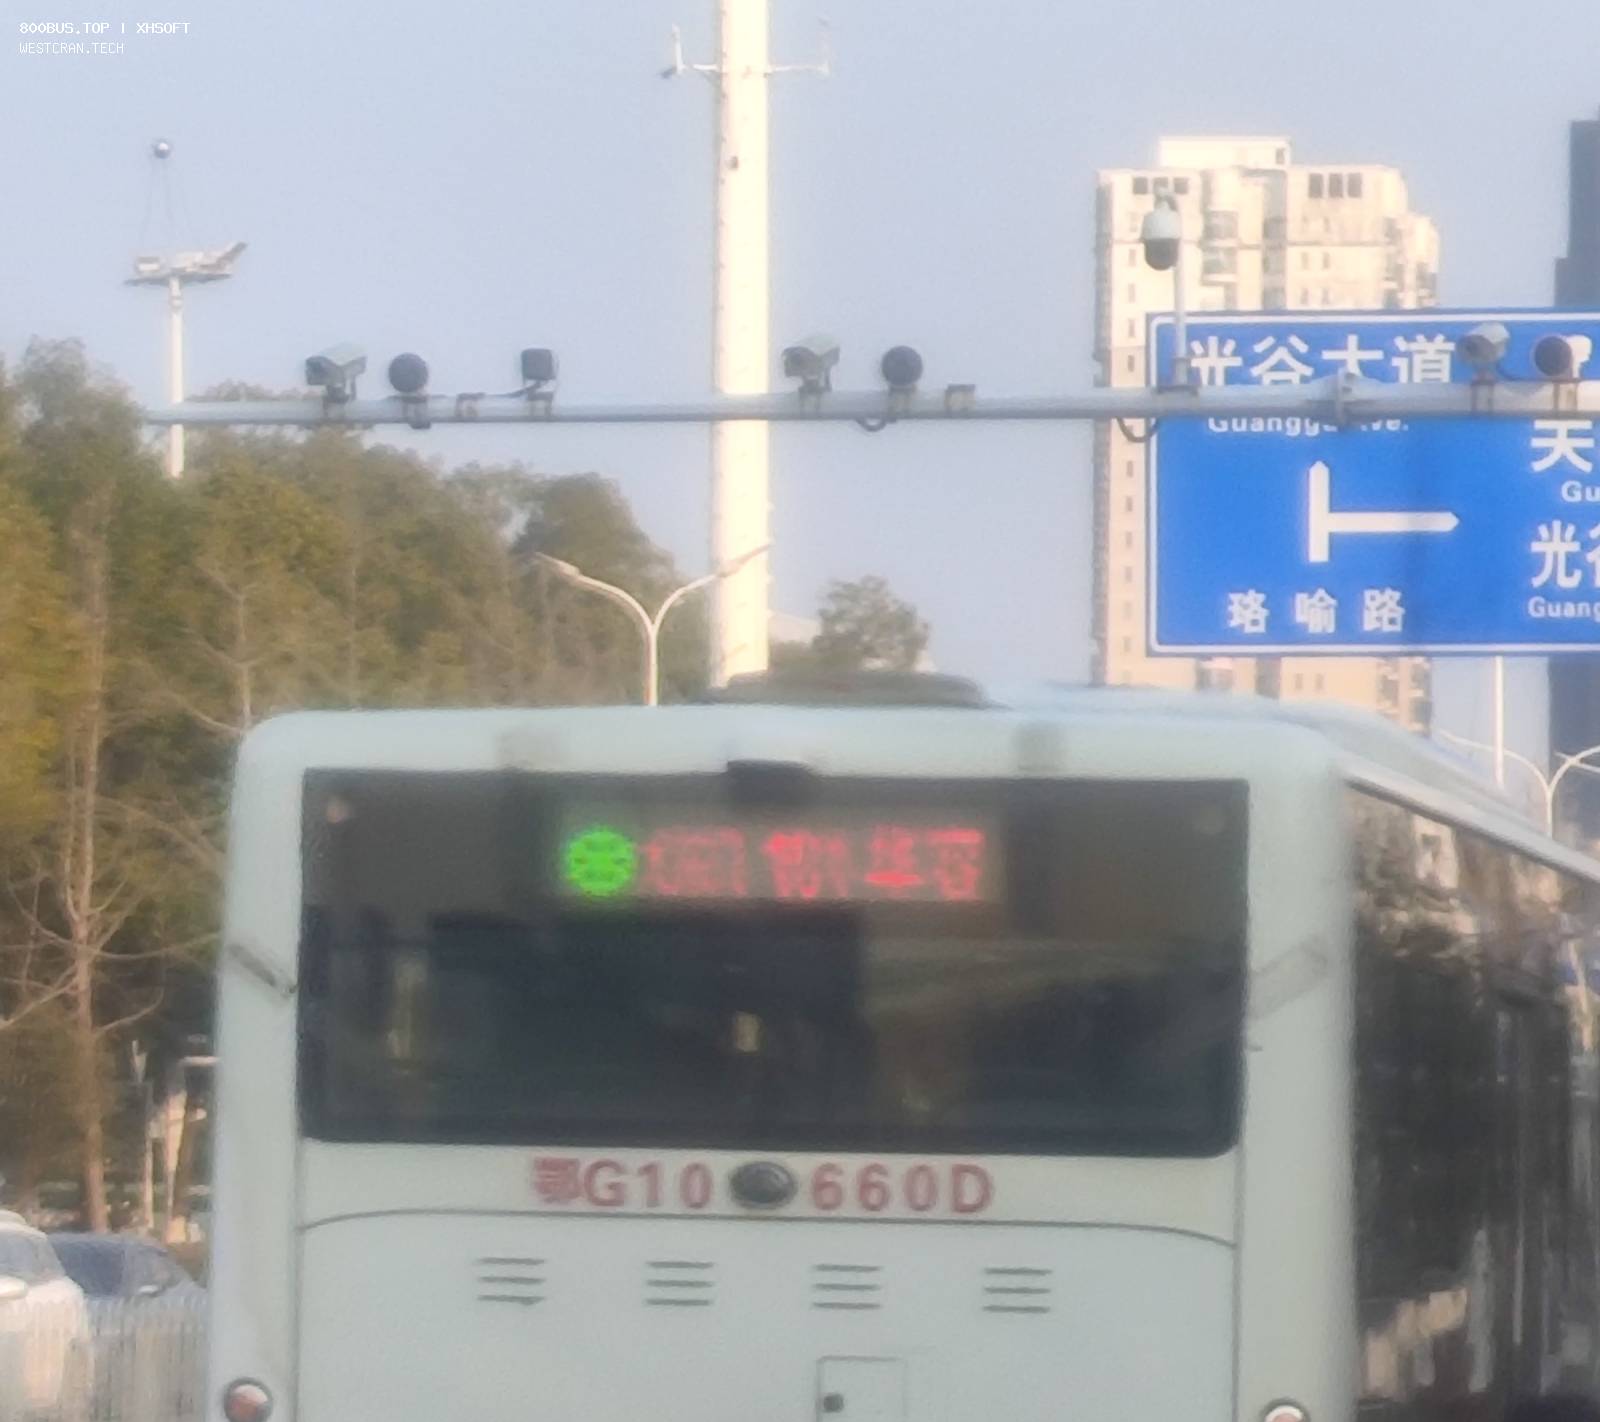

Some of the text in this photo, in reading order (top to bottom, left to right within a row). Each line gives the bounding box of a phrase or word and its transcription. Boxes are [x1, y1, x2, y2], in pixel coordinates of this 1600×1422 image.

[1189, 334, 1457, 387] 光谷大道
[1530, 519, 1600, 589] 光
[808, 1161, 994, 1214] 660D
